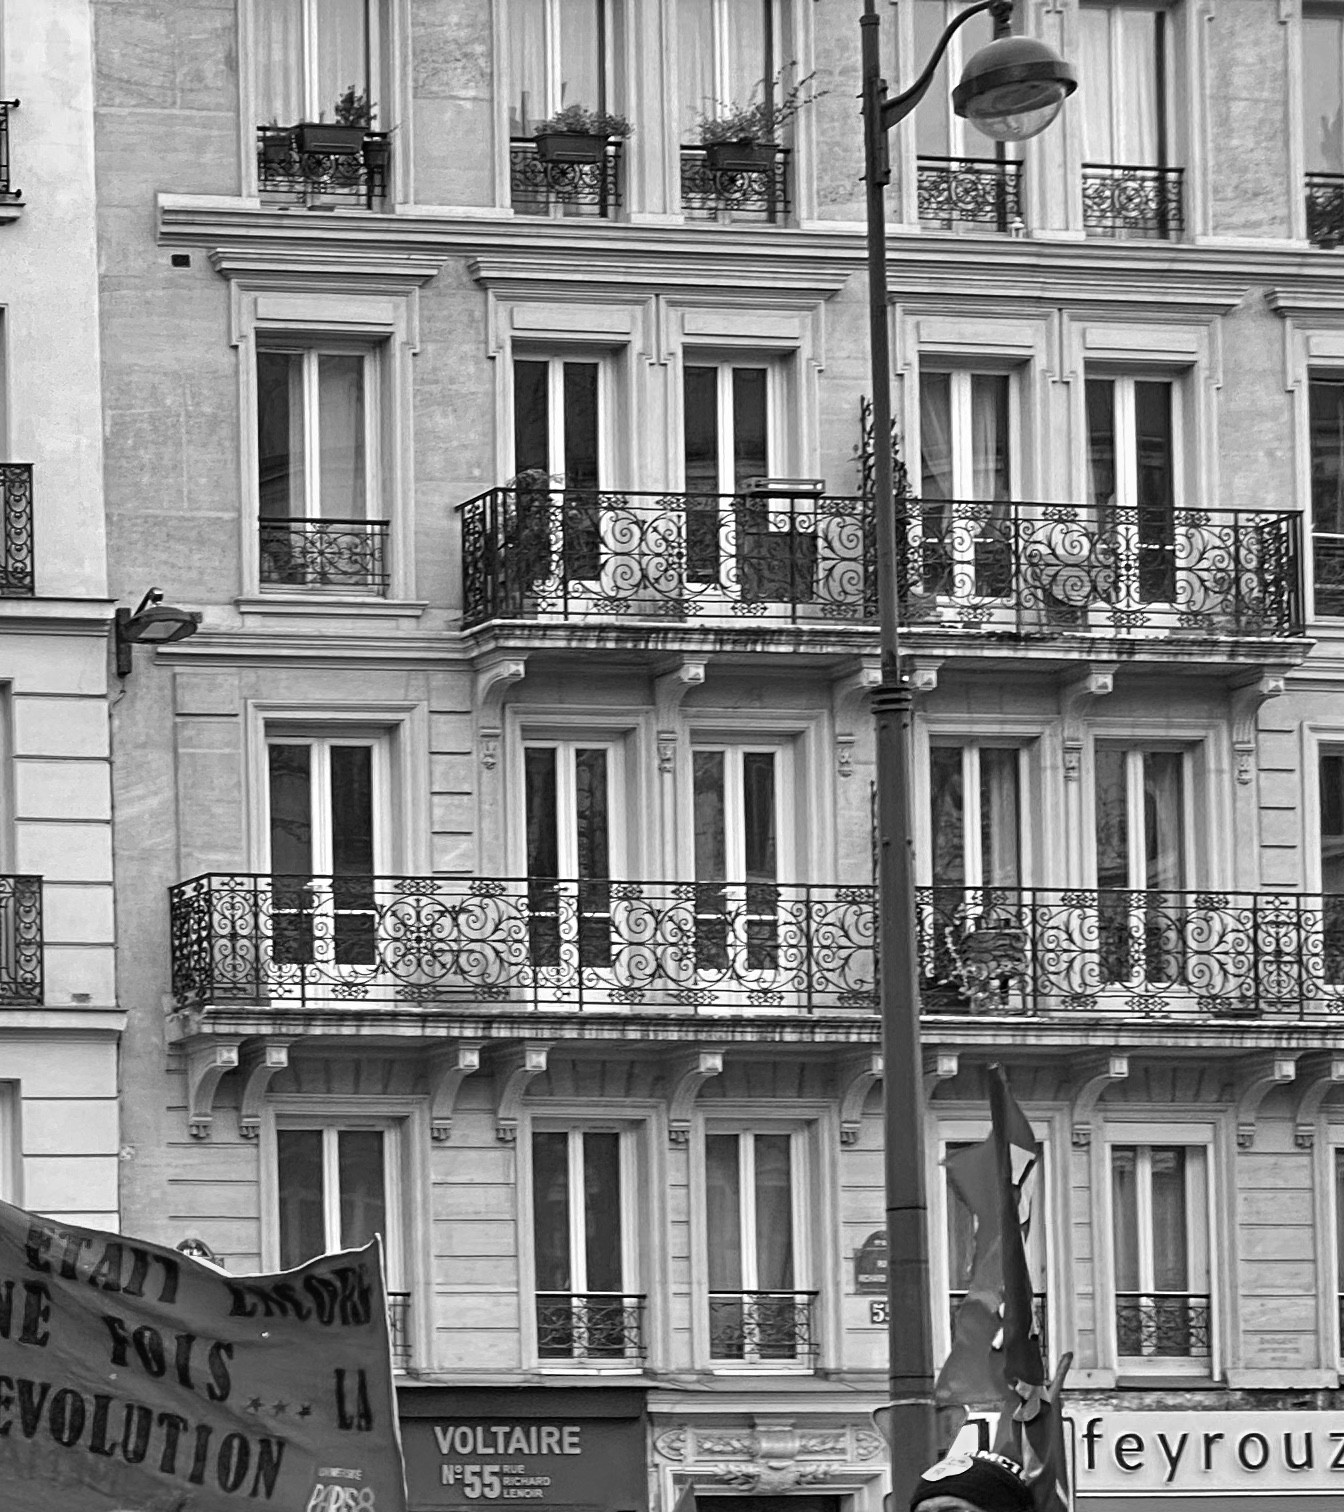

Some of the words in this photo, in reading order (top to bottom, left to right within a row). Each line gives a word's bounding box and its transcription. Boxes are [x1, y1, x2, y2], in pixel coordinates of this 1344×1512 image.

[872, 1303, 890, 1323] 5
[102, 1315, 234, 1402] FOIS
[334, 1368, 373, 1431] LA
[433, 1425, 582, 1455] VOLTAIRE
[502, 1476, 552, 1486] RICHARD
[502, 1488, 544, 1498] LENOIR
